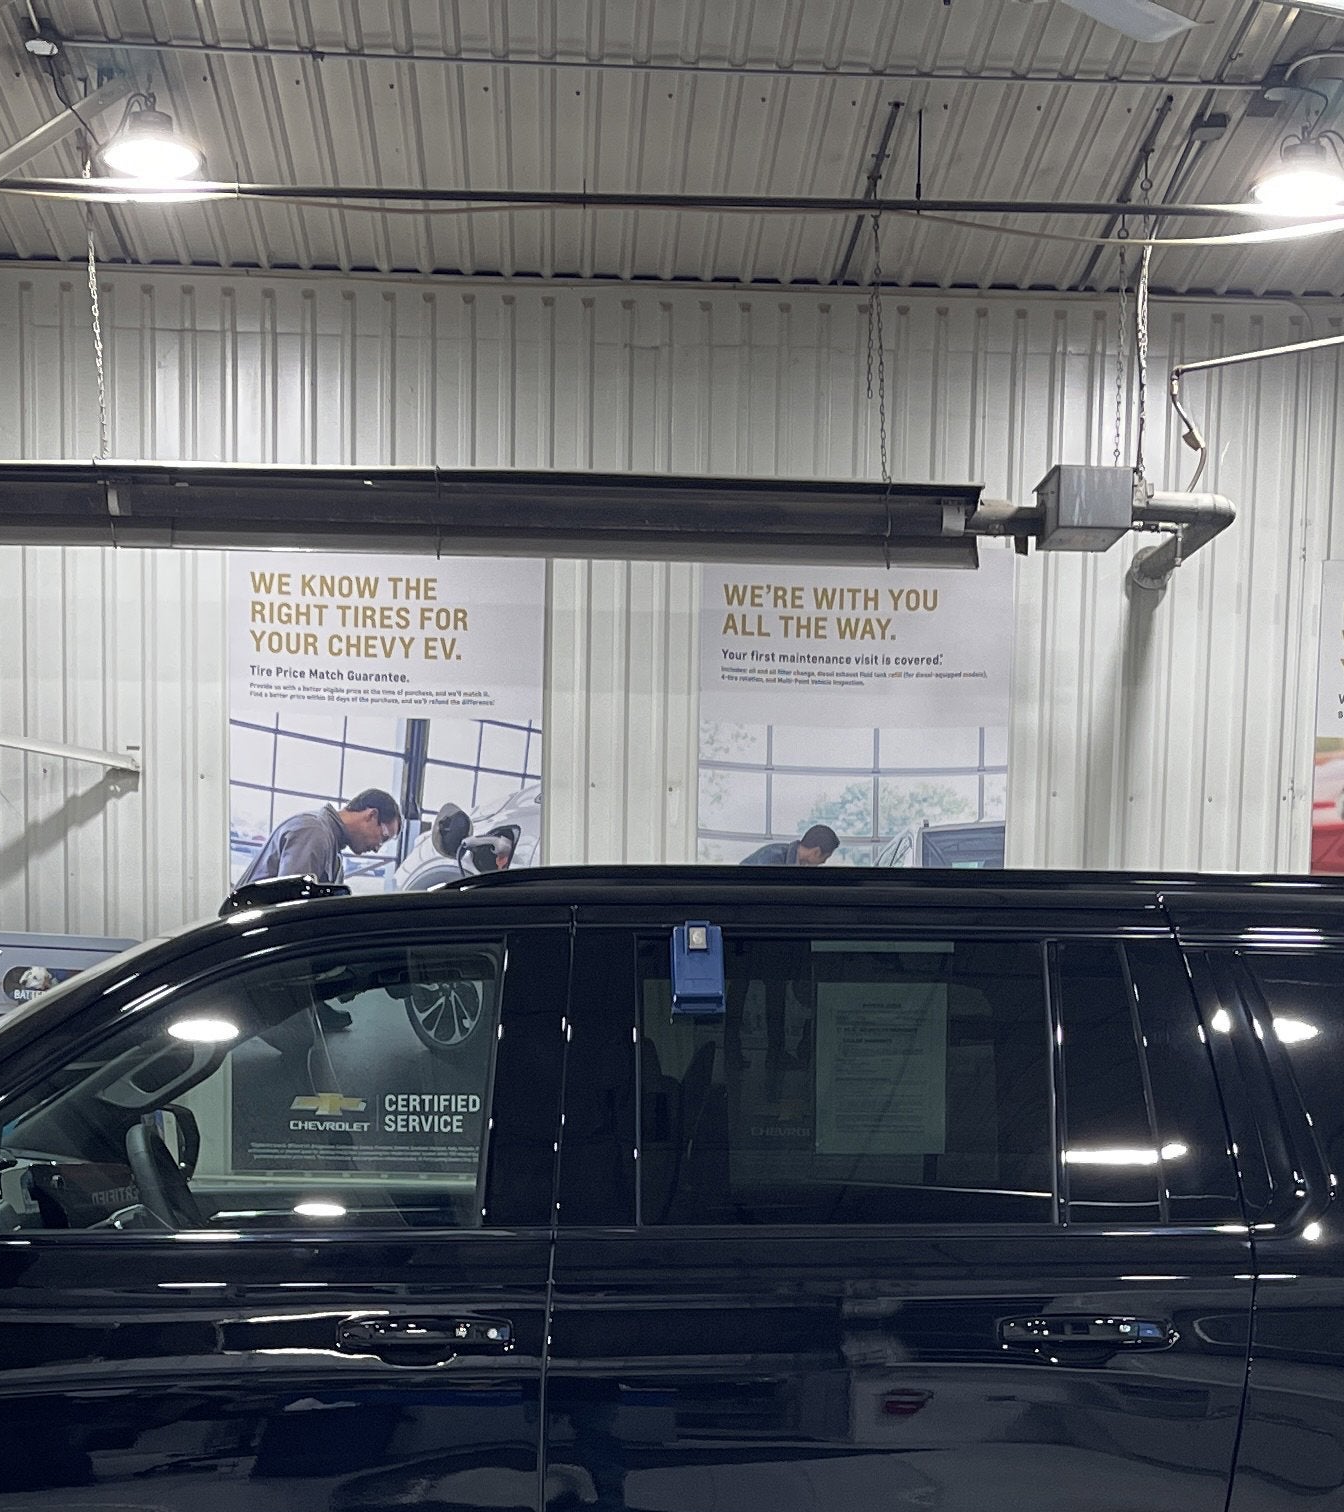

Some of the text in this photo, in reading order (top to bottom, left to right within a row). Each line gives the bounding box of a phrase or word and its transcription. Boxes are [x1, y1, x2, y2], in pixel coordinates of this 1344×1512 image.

[250, 571, 438, 600] WE KNOW THE
[723, 583, 938, 612] WE'RE WITH YOU
[250, 601, 468, 631] RIGHT TIRES FOR
[721, 613, 896, 641] ALL THE WAY.
[250, 629, 462, 660] YOUR CHEVY EV.
[722, 649, 747, 660] Your
[751, 650, 776, 662] first
[778, 652, 851, 665] maintenance
[855, 653, 878, 665] visit
[882, 653, 891, 665] is
[250, 665, 410, 683] Tire Price Match Guarantee.
[384, 1094, 481, 1113] CERTIFIED
[289, 1115, 464, 1133] CHEVROLET SERVICE
